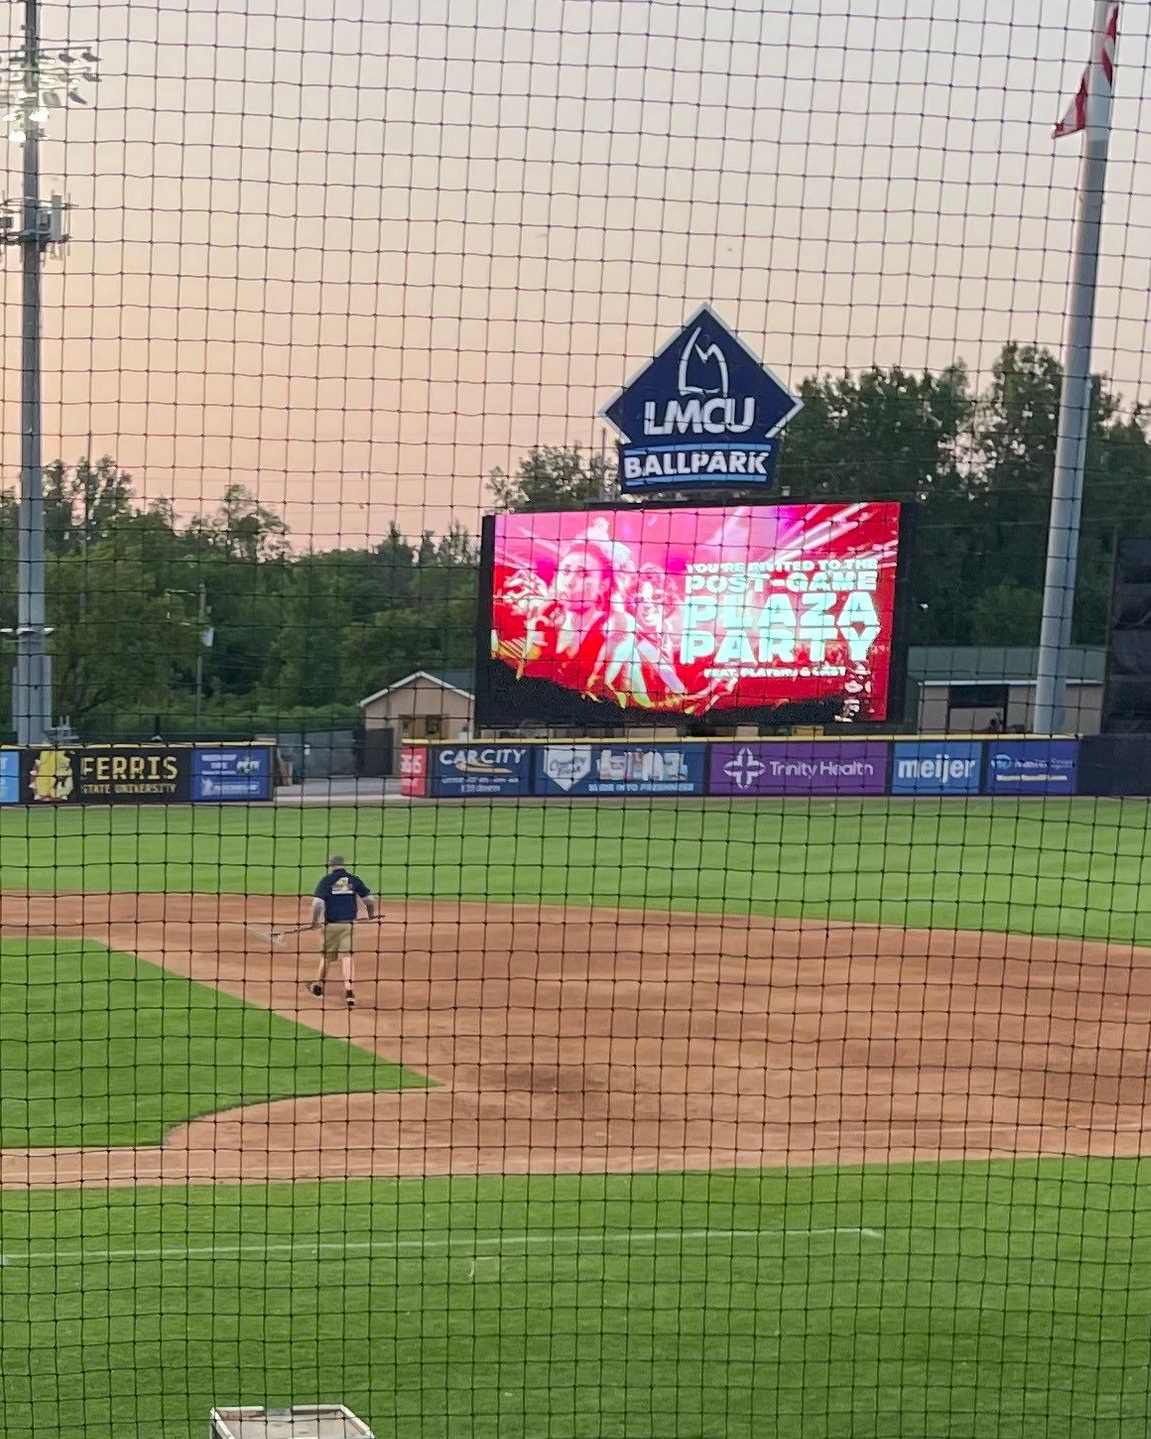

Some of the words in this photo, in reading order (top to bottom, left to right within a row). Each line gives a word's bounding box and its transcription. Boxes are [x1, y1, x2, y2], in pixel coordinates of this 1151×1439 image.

[644, 397, 755, 436] LMCU
[624, 451, 769, 479] BALLPARK
[685, 571, 877, 593] POST-GAME
[682, 592, 880, 628] PLAZA
[680, 627, 882, 664] PARTY
[80, 756, 178, 780] FERRIS
[769, 761, 817, 779] Trinity
[820, 761, 874, 776] Health
[898, 754, 976, 784] meijer
[81, 783, 110, 794] STATE
[114, 783, 178, 794] UNIVERSITY
